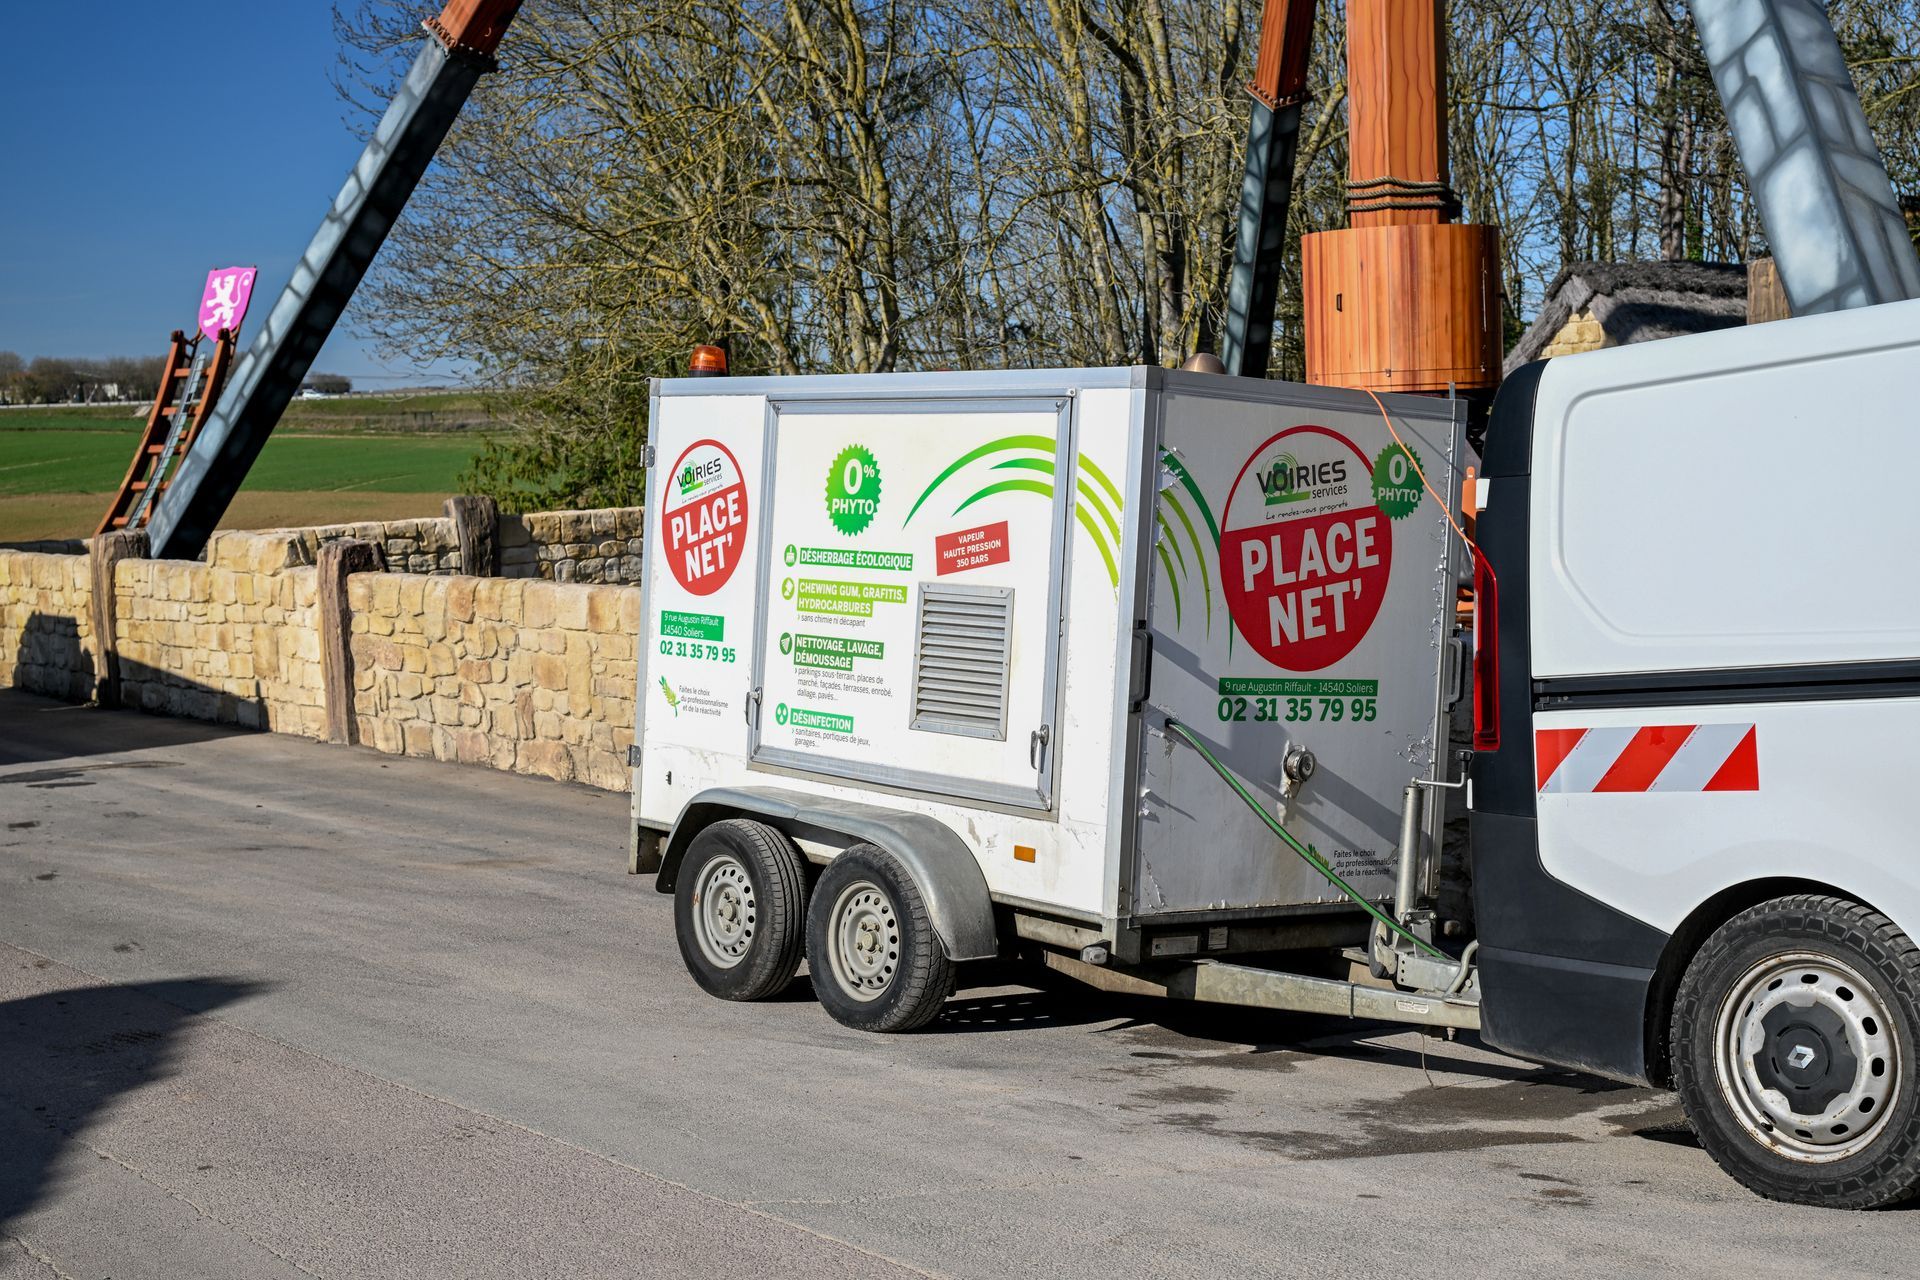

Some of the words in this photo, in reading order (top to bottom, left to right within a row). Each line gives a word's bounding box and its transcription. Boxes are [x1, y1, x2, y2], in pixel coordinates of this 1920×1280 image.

[676, 457, 722, 488] VOIRIES
[704, 473, 723, 487] services
[843, 458, 876, 495] 0%
[1256, 459, 1347, 497] VOIRIES
[1312, 483, 1348, 499] services
[1378, 487, 1419, 503] PHYTO
[832, 498, 875, 516] PHYTO
[671, 490, 742, 550] PLACE
[1266, 511, 1275, 520] Le
[958, 531, 985, 545] VAPEUR
[943, 546, 966, 560] HAUTE
[966, 539, 1002, 557] PRESSION
[1241, 516, 1380, 593] PLACE
[801, 547, 855, 566] DÉSHERBAGE
[856, 550, 912, 571] ÉCOLOGIQUE
[956, 557, 970, 568] 350
[970, 554, 989, 566] BARS
[799, 582, 838, 596] CHEWING
[840, 585, 861, 598] GUM,
[863, 587, 905, 602] GRAFITIS,
[799, 598, 871, 613] HYDROCARBURES
[801, 615, 813, 623] sans
[814, 614, 832, 625] chimie
[833, 616, 839, 625] ni
[840, 617, 866, 628] décapant
[664, 624, 683, 636] 14540
[683, 626, 704, 639] Soliers
[660, 640, 673, 656] 02
[676, 642, 687, 657] 31
[690, 643, 703, 659] 35
[706, 645, 719, 661] 79
[722, 647, 736, 663] 95
[796, 636, 846, 653] NETTOYAGE,
[847, 642, 882, 657] LAVAGE,
[795, 652, 851, 668] DÉMOUSSAGE
[798, 668, 821, 679] parkings
[857, 674, 875, 685] places
[877, 676, 884, 685] de
[1225, 681, 1231, 691] 9
[1232, 683, 1246, 691] rue
[1247, 681, 1282, 694] Augustin
[1284, 681, 1312, 692] Riffault
[1319, 682, 1345, 693] 14540
[1346, 682, 1374, 694] Soliers
[1217, 697, 1248, 722] 02
[1254, 698, 1279, 722] 31
[1285, 698, 1312, 722] 35
[1318, 698, 1344, 722] 79
[1351, 698, 1377, 723] 95
[792, 711, 851, 731] DÉSINFECTION
[823, 731, 848, 743] portiques
[849, 735, 857, 744] de
[1334, 849, 1352, 858] Faites
[1353, 849, 1359, 857] le
[1359, 848, 1376, 857] choix
[1336, 859, 1344, 867] du
[1339, 869, 1345, 877] et
[1346, 868, 1354, 877] de
[1355, 868, 1360, 876] la
